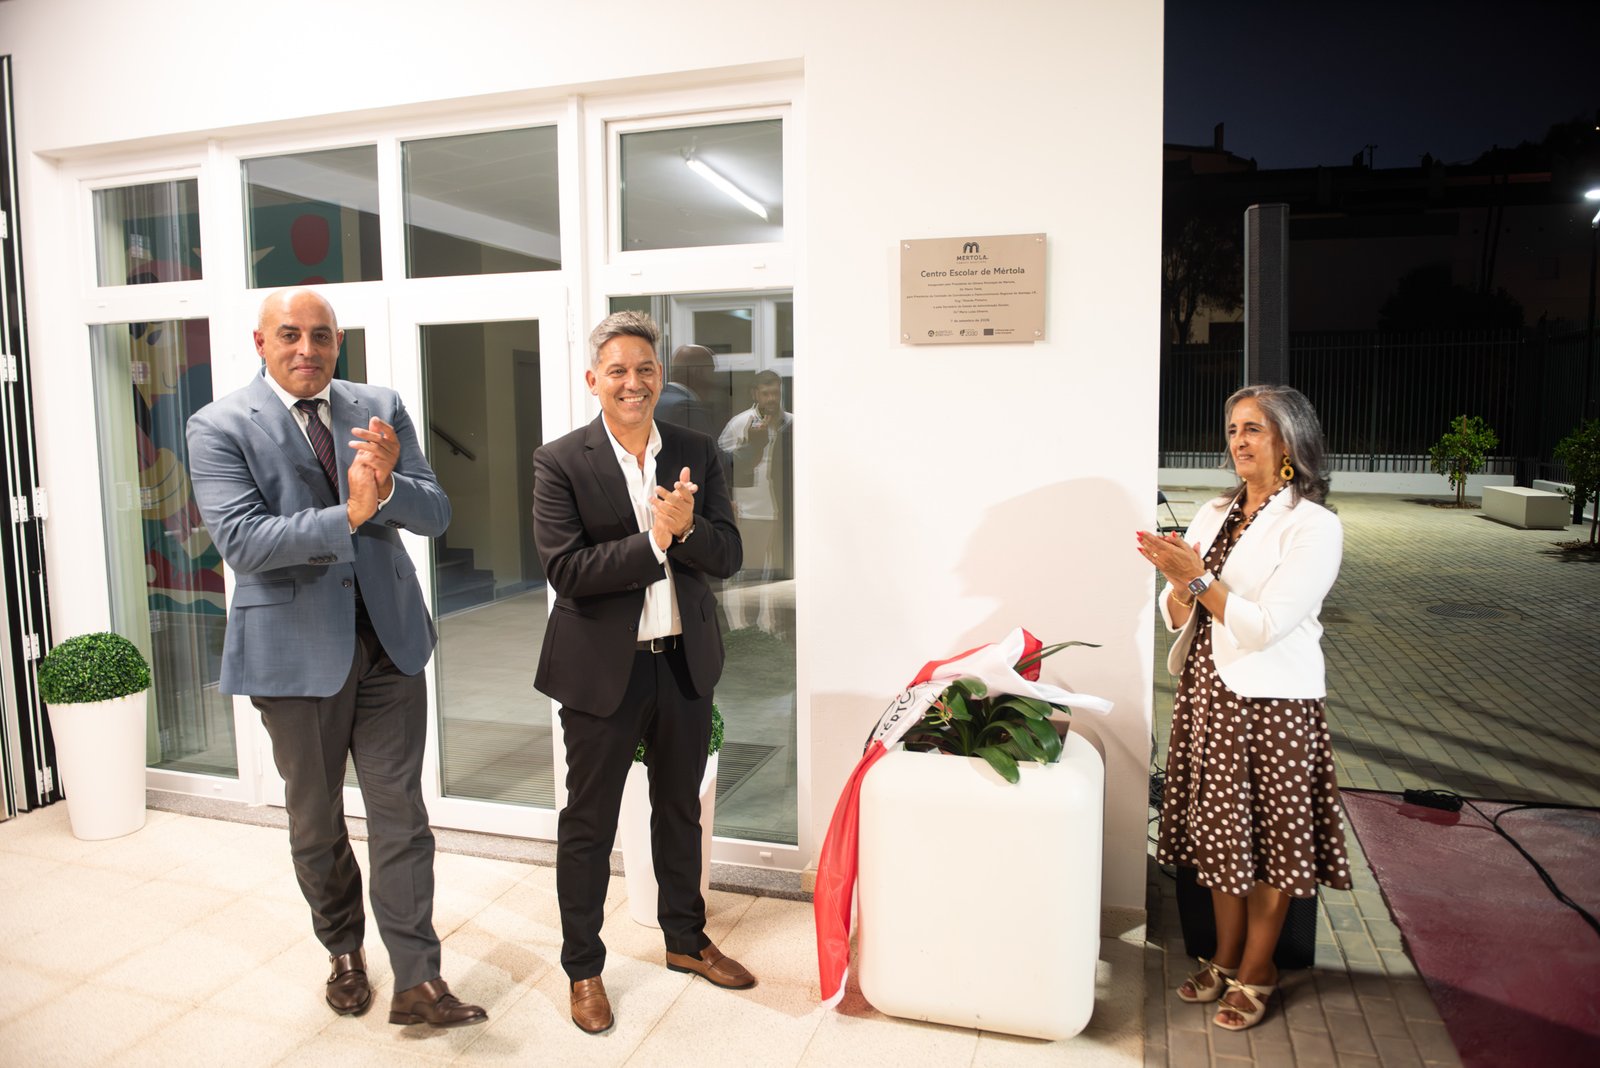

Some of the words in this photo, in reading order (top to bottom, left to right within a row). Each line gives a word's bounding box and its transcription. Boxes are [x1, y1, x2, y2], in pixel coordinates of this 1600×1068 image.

[920, 270, 947, 278] Centro
[949, 268, 978, 277] Escolar
[980, 268, 991, 276] de
[993, 266, 1025, 275] Mértola
